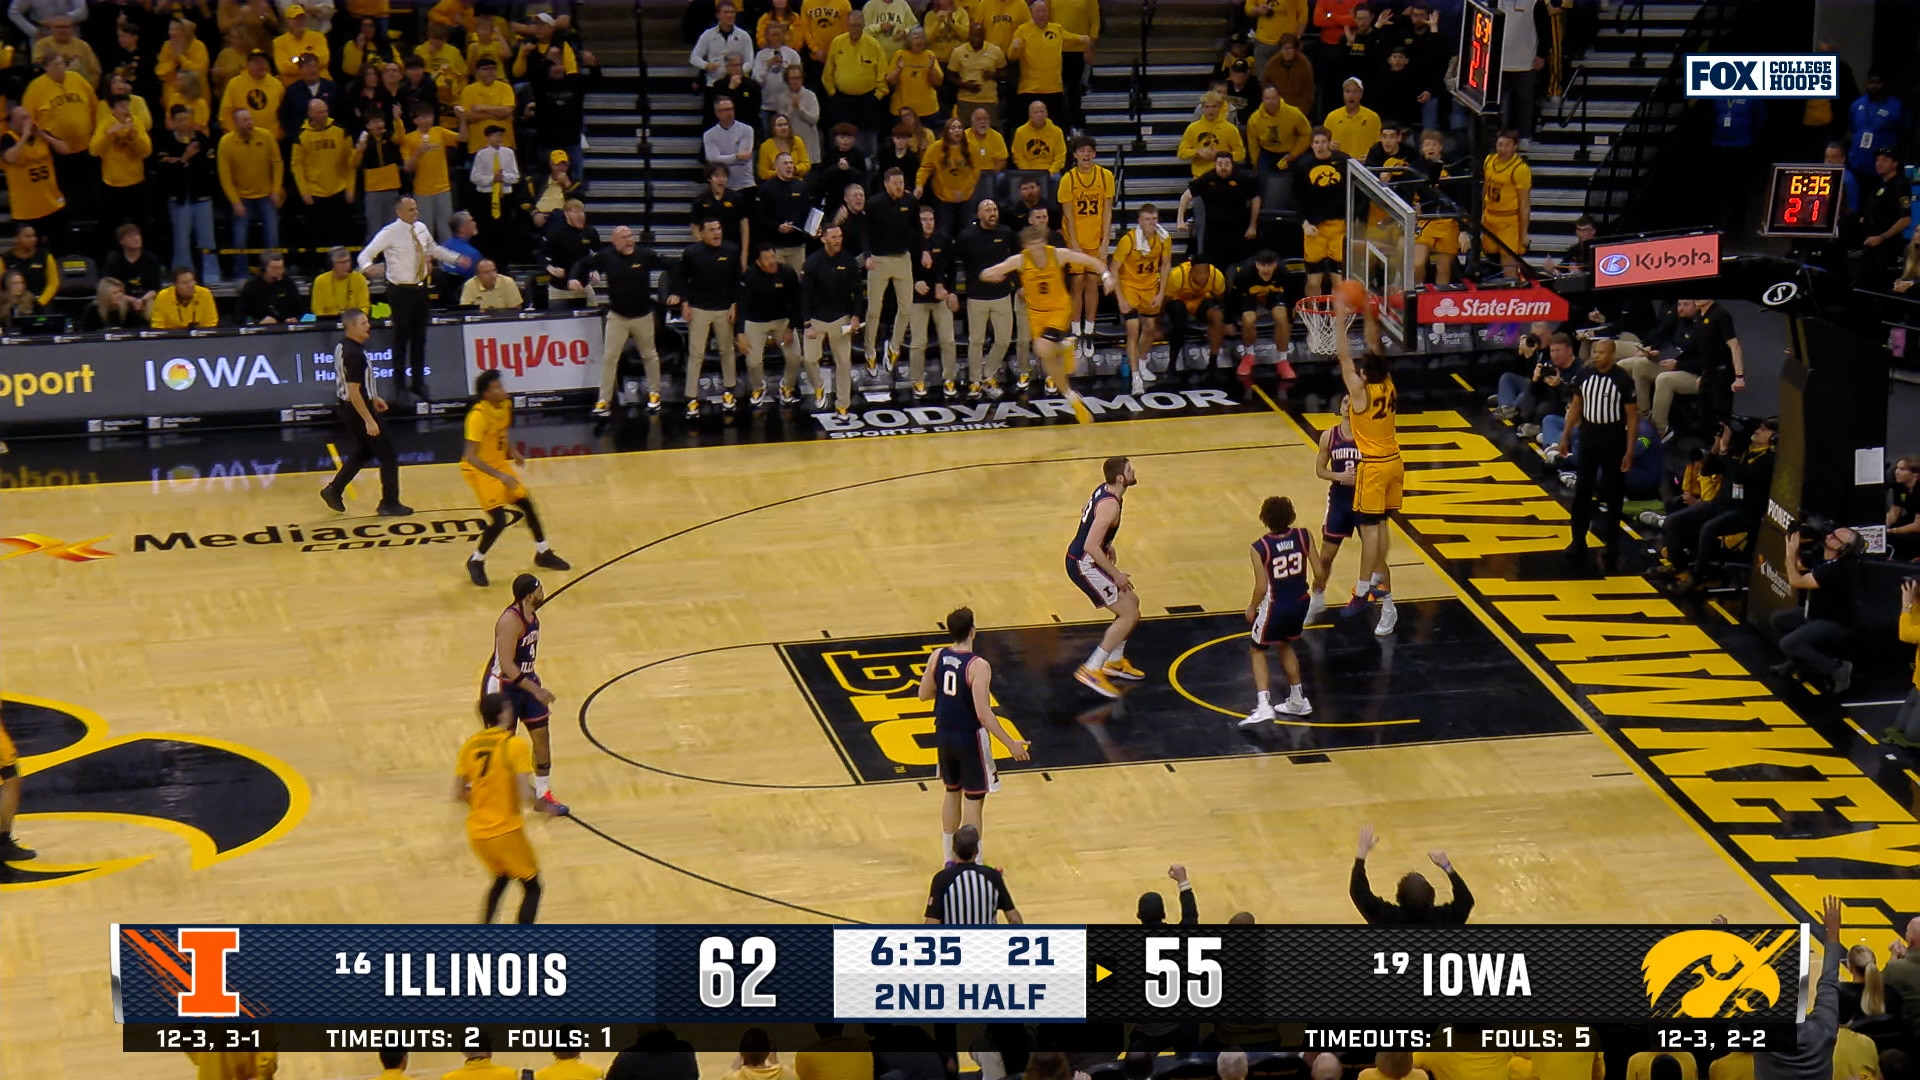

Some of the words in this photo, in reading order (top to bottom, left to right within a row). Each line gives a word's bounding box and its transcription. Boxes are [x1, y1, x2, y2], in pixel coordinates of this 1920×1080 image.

[807, 8, 841, 19] IOWA
[873, 11, 903, 25] IOWA
[992, 15, 1013, 24] IOWA
[1469, 41, 1490, 91] 21
[29, 166, 49, 182] 55
[1790, 176, 1831, 195] 6:35
[1077, 200, 1099, 215] 23
[1784, 198, 1820, 223] 21
[1636, 249, 1711, 270] Kubota
[475, 334, 590, 377] HyVee
[145, 355, 280, 391] IOWA
[811, 388, 1240, 433] BODYARMOR
[829, 425, 936, 439] SPORTS
[938, 420, 1009, 433] DRINK
[1303, 411, 1605, 560] IOWA
[133, 516, 494, 553] Mediacom
[301, 534, 485, 553] COURT
[1273, 552, 1302, 579] 23
[943, 670, 957, 696] 0
[475, 750, 492, 776] 7
